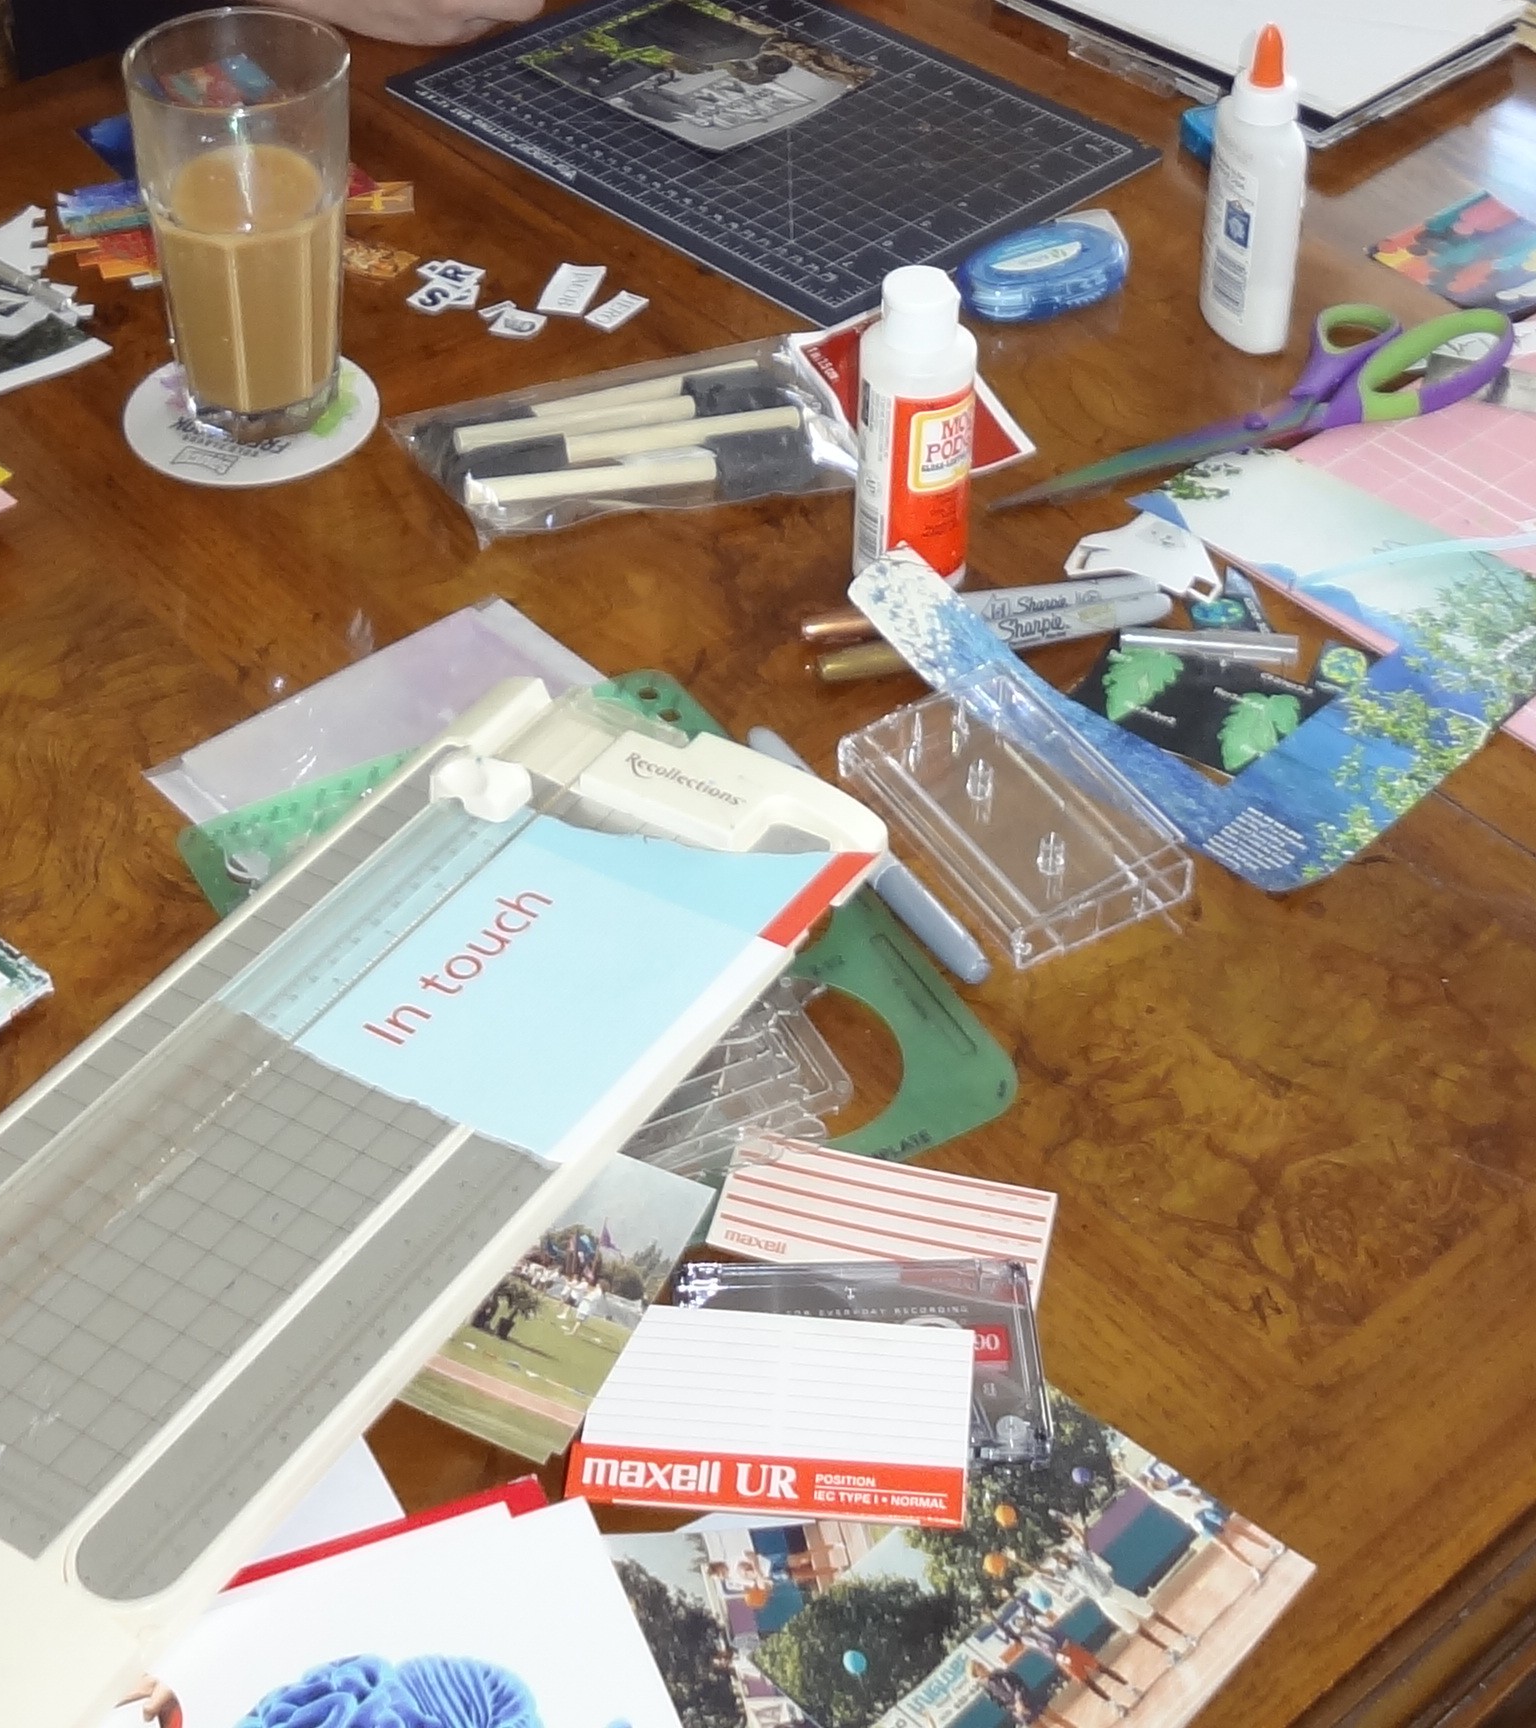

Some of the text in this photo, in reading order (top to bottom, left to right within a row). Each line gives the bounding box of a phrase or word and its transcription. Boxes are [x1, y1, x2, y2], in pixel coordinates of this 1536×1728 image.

[418, 287, 451, 308] S
[595, 294, 644, 325] HERO
[1014, 594, 1069, 614] Sharpie
[998, 613, 1070, 640] Sharpie
[624, 752, 746, 806] Recollections
[363, 889, 554, 1046] In touch
[724, 1228, 788, 1256] maxell
[785, 1304, 969, 1318] FOR EVERYDAY RECORDING
[581, 1456, 800, 1500] maxell UR
[814, 1473, 877, 1488] POSITION
[814, 1490, 836, 1502] IEC
[837, 1491, 870, 1504] TYPE
[890, 1494, 949, 1511] NORMAL
